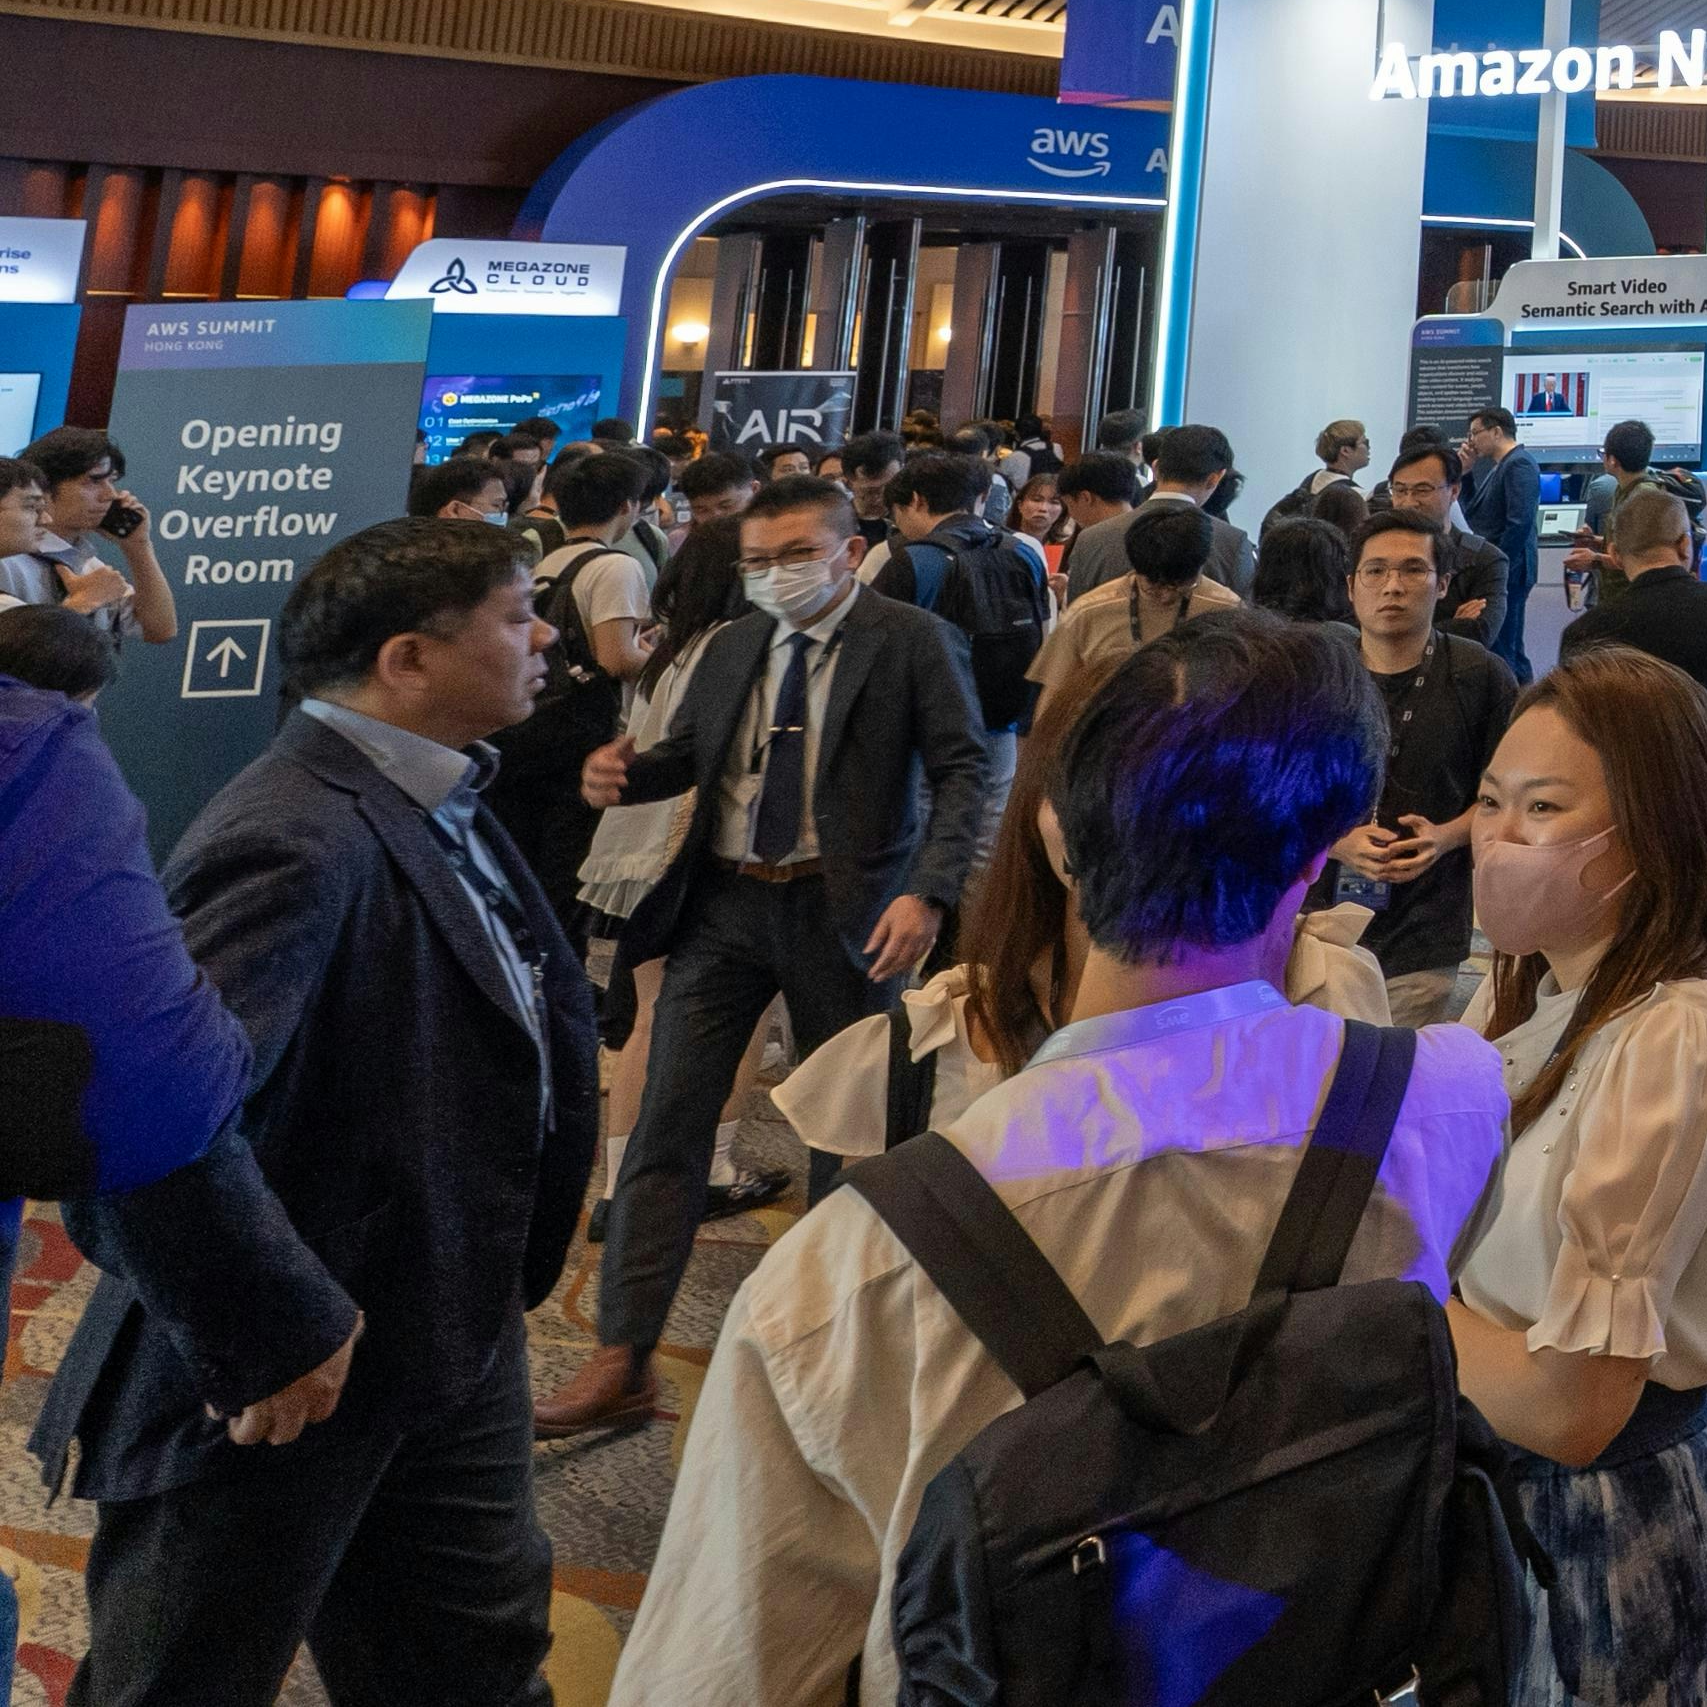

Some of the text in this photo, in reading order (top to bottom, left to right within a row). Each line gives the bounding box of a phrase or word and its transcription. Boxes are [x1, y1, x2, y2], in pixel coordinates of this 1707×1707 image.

[1368, 41, 1634, 100] Amazon
[1030, 127, 1110, 158] aws
[486, 274, 588, 286] CLOUD
[488, 261, 590, 274] MEGAZONE
[1567, 279, 1667, 296] Smart Video
[1521, 301, 1595, 318] Semantic
[1600, 301, 1654, 316] Search
[1659, 300, 1695, 314] with
[147, 319, 277, 336] AWS SUMMIT
[144, 340, 225, 353] HONG KONG
[181, 415, 343, 456] Opening
[735, 409, 823, 443] AIR
[177, 463, 333, 501] Keynote
[159, 505, 338, 540] Overflow
[184, 555, 294, 585] Room
